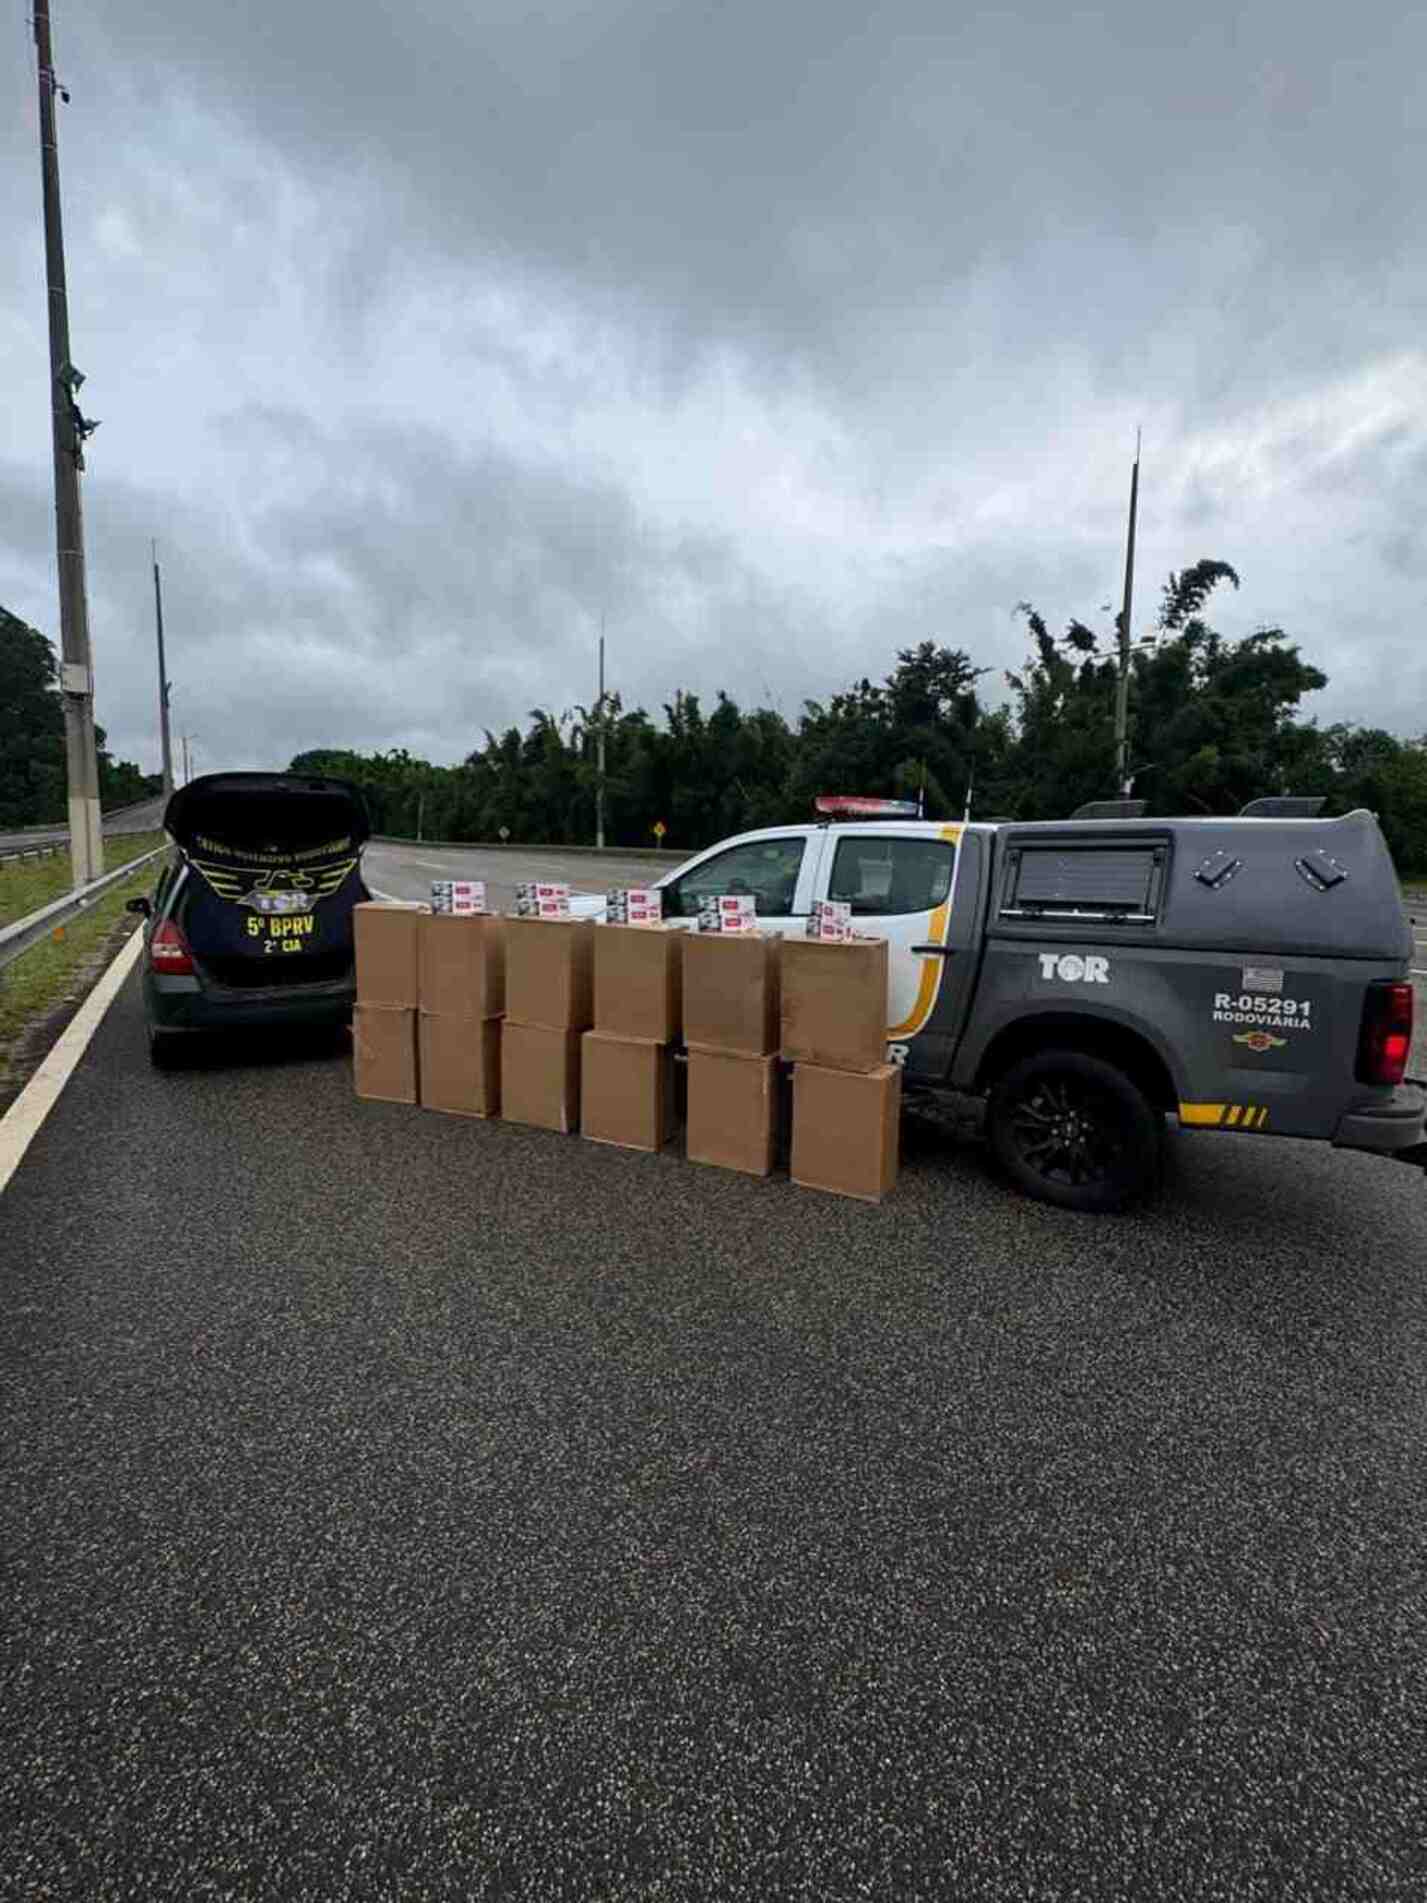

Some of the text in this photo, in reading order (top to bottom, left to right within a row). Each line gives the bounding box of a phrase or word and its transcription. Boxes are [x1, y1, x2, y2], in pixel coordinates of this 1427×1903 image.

[270, 915, 314, 936] BPRV
[282, 939, 302, 952] CIA
[1038, 953, 1110, 983] TOR
[1213, 992, 1312, 1017] R-05291
